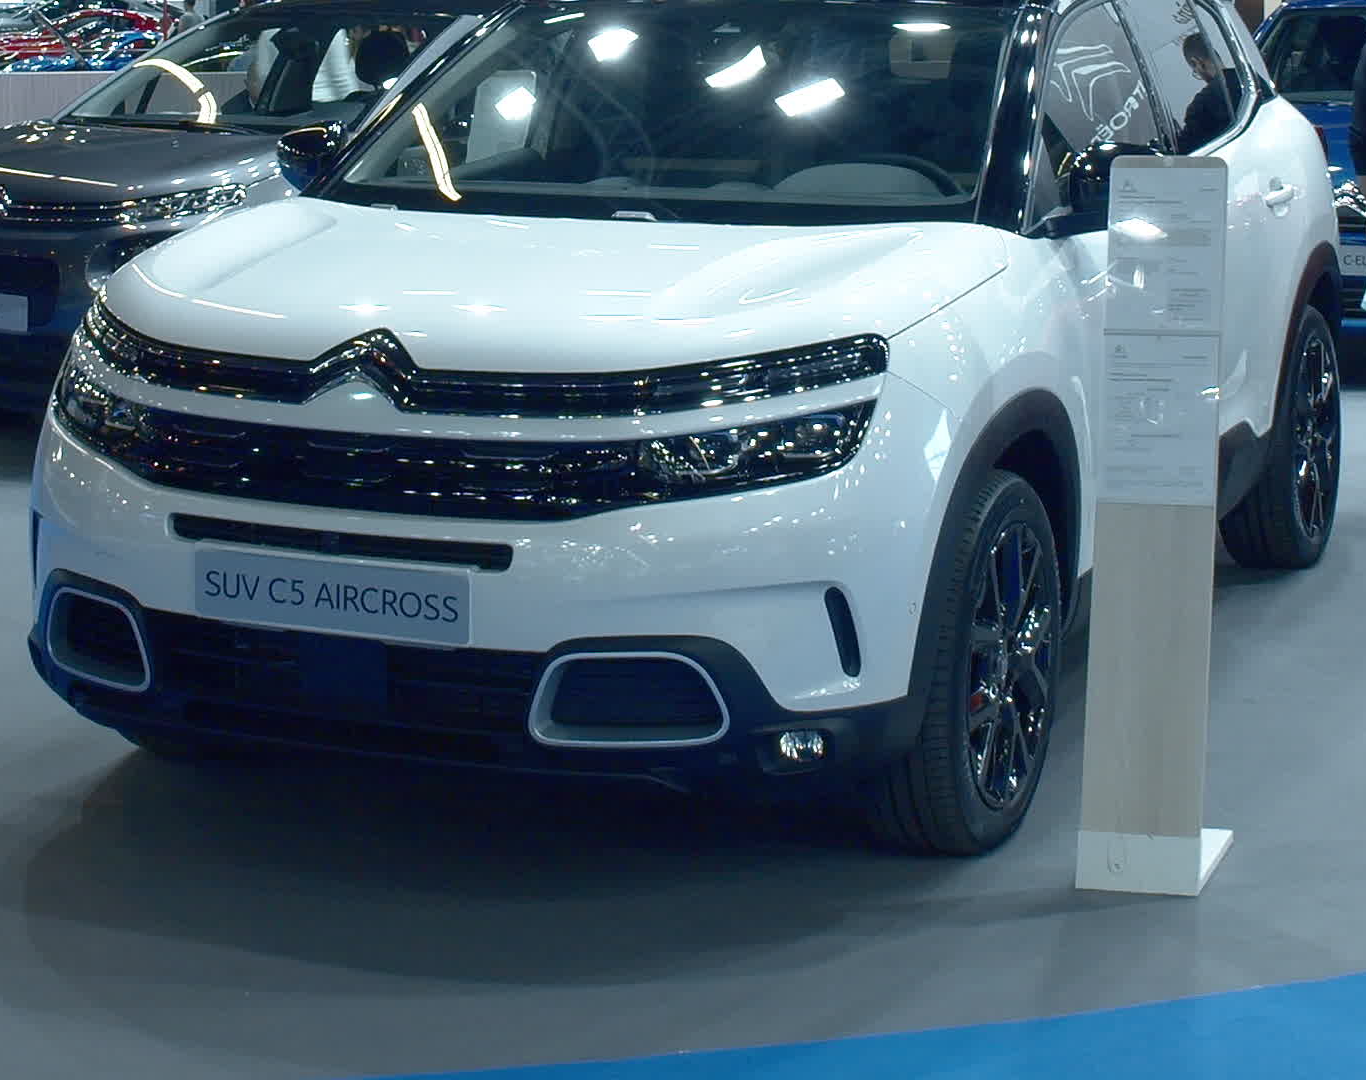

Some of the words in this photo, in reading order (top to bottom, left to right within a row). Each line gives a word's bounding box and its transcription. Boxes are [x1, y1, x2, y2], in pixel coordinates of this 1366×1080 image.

[204, 570, 260, 601] SUV
[268, 577, 306, 606] C5
[314, 582, 460, 623] AIRCROSS
